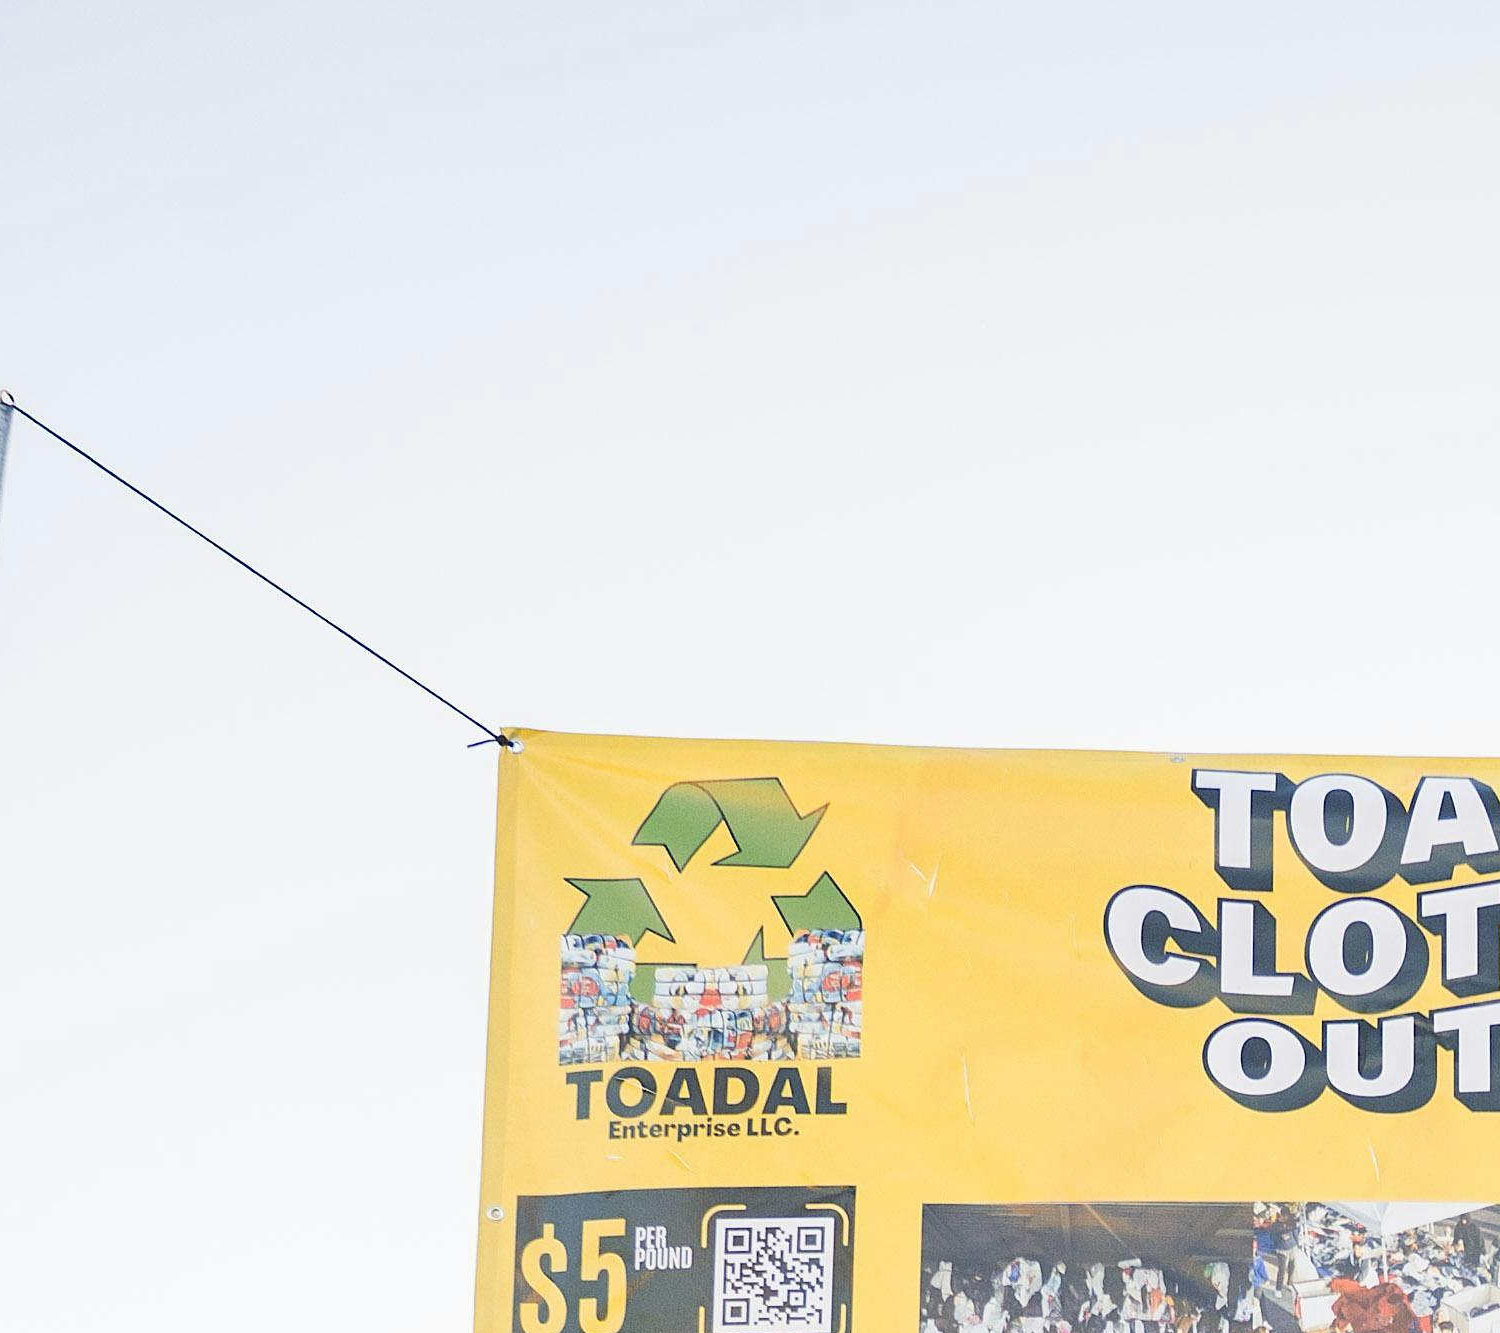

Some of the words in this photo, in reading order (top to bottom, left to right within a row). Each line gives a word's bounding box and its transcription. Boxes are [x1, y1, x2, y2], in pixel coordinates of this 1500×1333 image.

[566, 1066, 848, 1120] TOADAL
[609, 1119, 740, 1142] Enterprise
[747, 1117, 800, 1137] LLC.
[635, 1226, 667, 1249] PER
[634, 1247, 693, 1271] POUND
